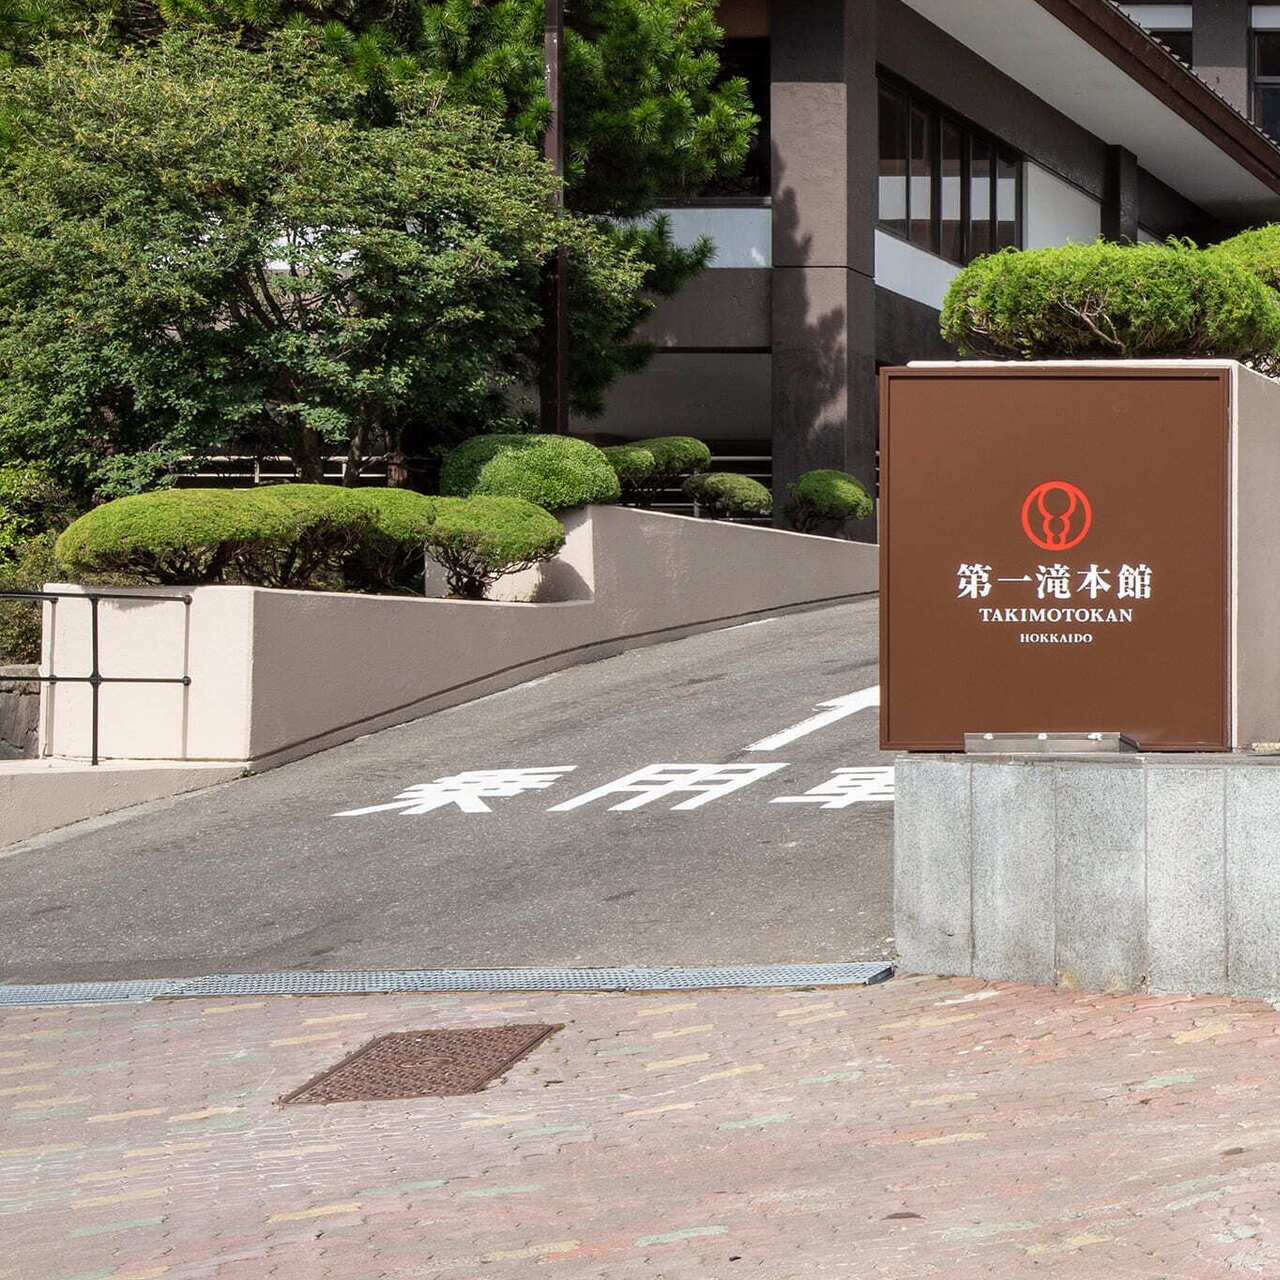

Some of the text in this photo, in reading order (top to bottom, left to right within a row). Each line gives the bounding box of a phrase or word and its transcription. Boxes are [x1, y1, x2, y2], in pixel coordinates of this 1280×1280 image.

[956, 563, 1153, 600] 第一滝本館
[978, 608, 1133, 623] TAKIMOTOKAN
[1020, 633, 1093, 643] HOKKAIDO
